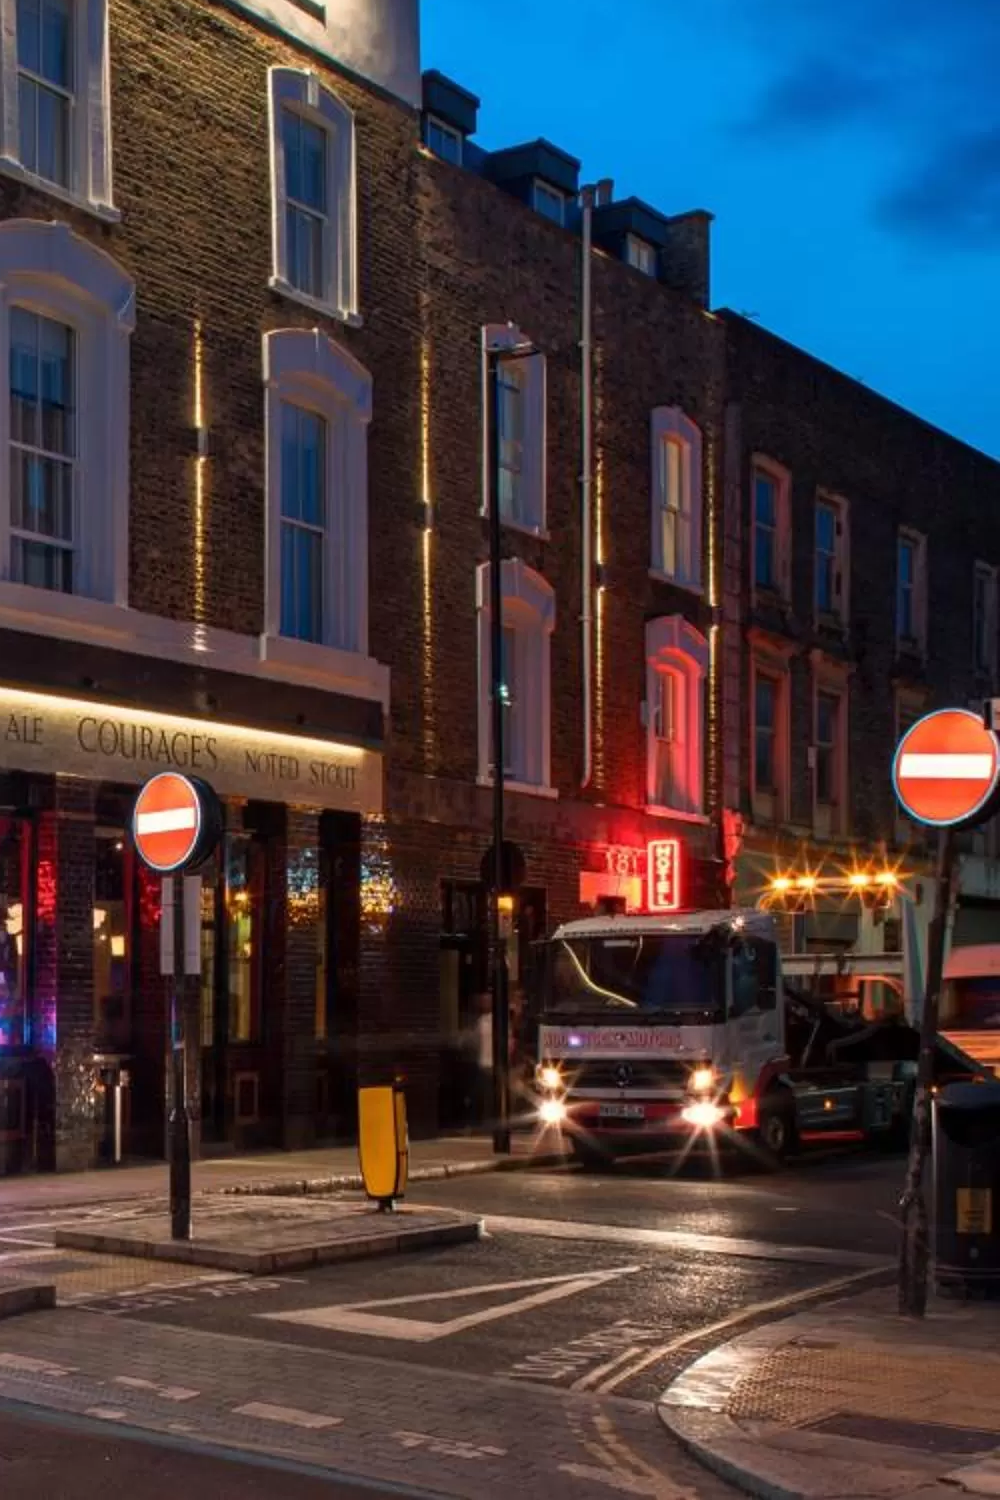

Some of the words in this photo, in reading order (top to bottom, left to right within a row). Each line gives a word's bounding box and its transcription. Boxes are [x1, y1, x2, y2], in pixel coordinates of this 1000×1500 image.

[4, 713, 44, 745] ALE
[244, 748, 300, 781] NOTED
[309, 760, 357, 789] STOUT
[655, 845, 672, 906] HOTEL
